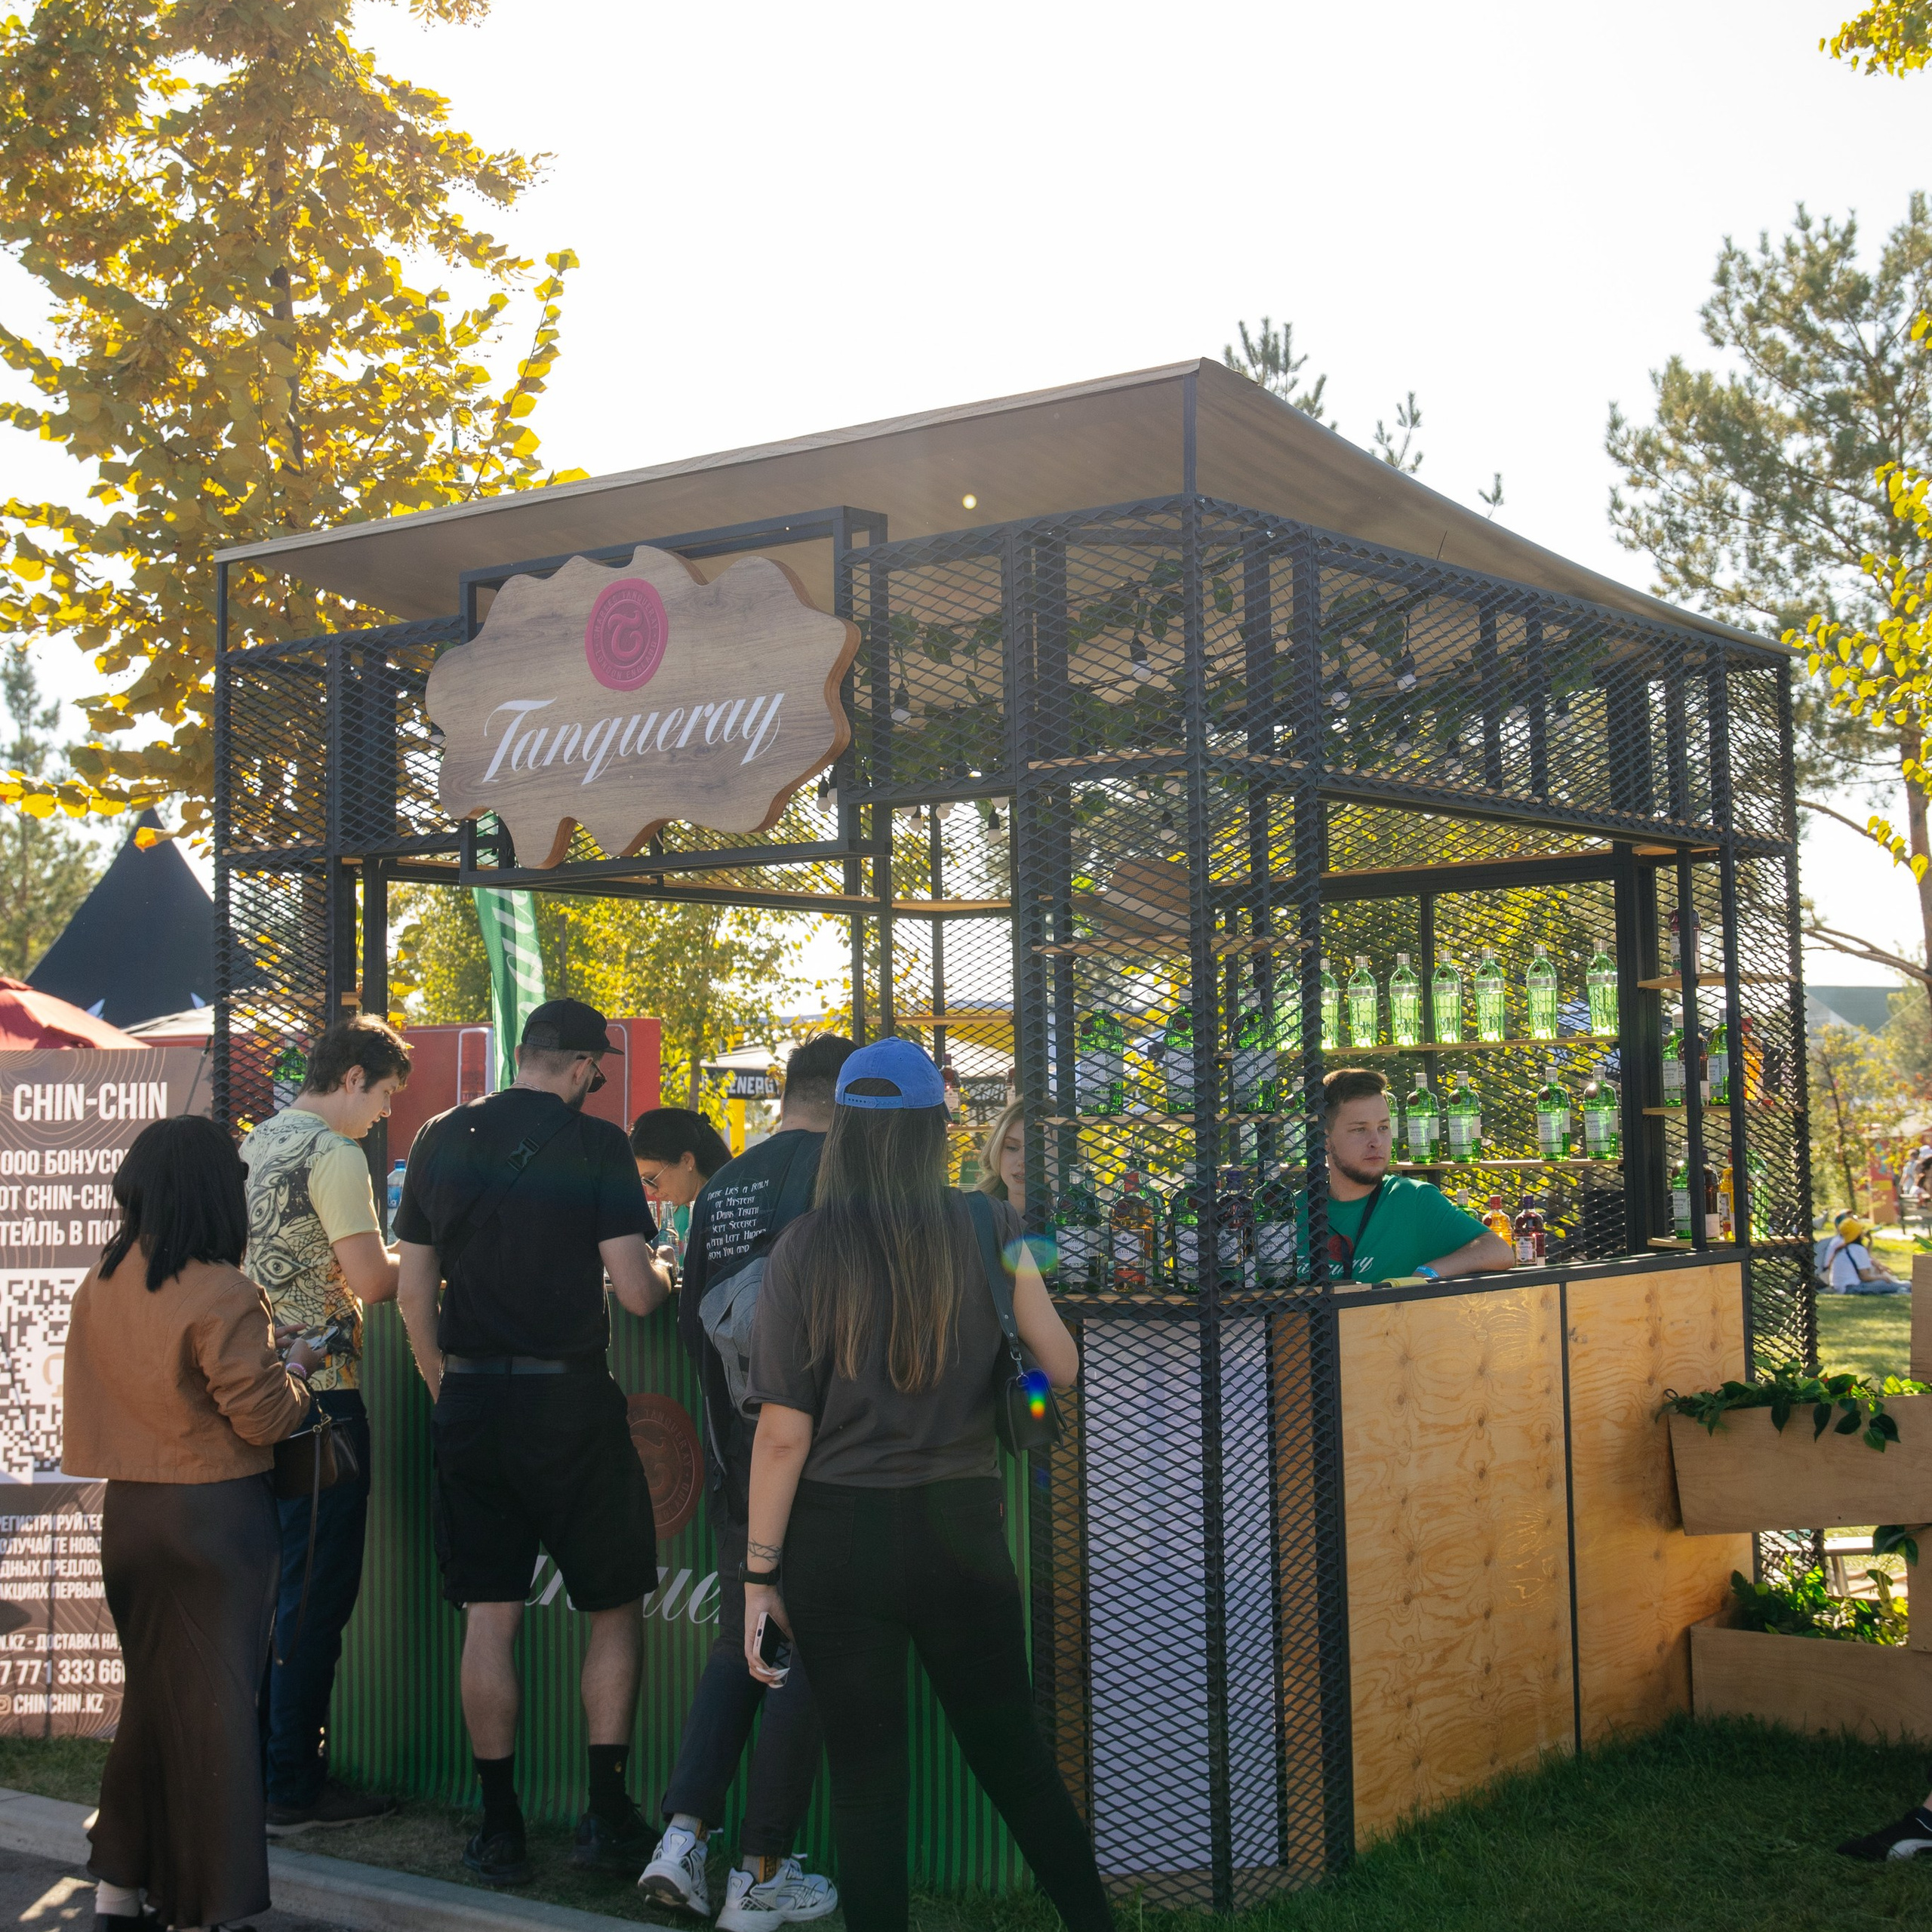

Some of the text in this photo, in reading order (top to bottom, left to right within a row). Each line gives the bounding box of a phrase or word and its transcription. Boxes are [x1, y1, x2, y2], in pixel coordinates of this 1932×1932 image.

[481, 692, 786, 786] Tanqueray
[13, 1081, 168, 1122] CHIN-CHIN
[45, 1148, 129, 1175] БОНУСО
[726, 1195, 755, 1207] MYSTERY
[69, 1220, 83, 1245] В
[726, 1233, 740, 1244] LEFT
[35, 1633, 100, 1652] ДОСТАВКА
[17, 1660, 52, 1685] 771
[58, 1659, 95, 1685] 333
[99, 1659, 125, 1685] 66
[14, 1693, 104, 1715] CHINCHIN.KZ
